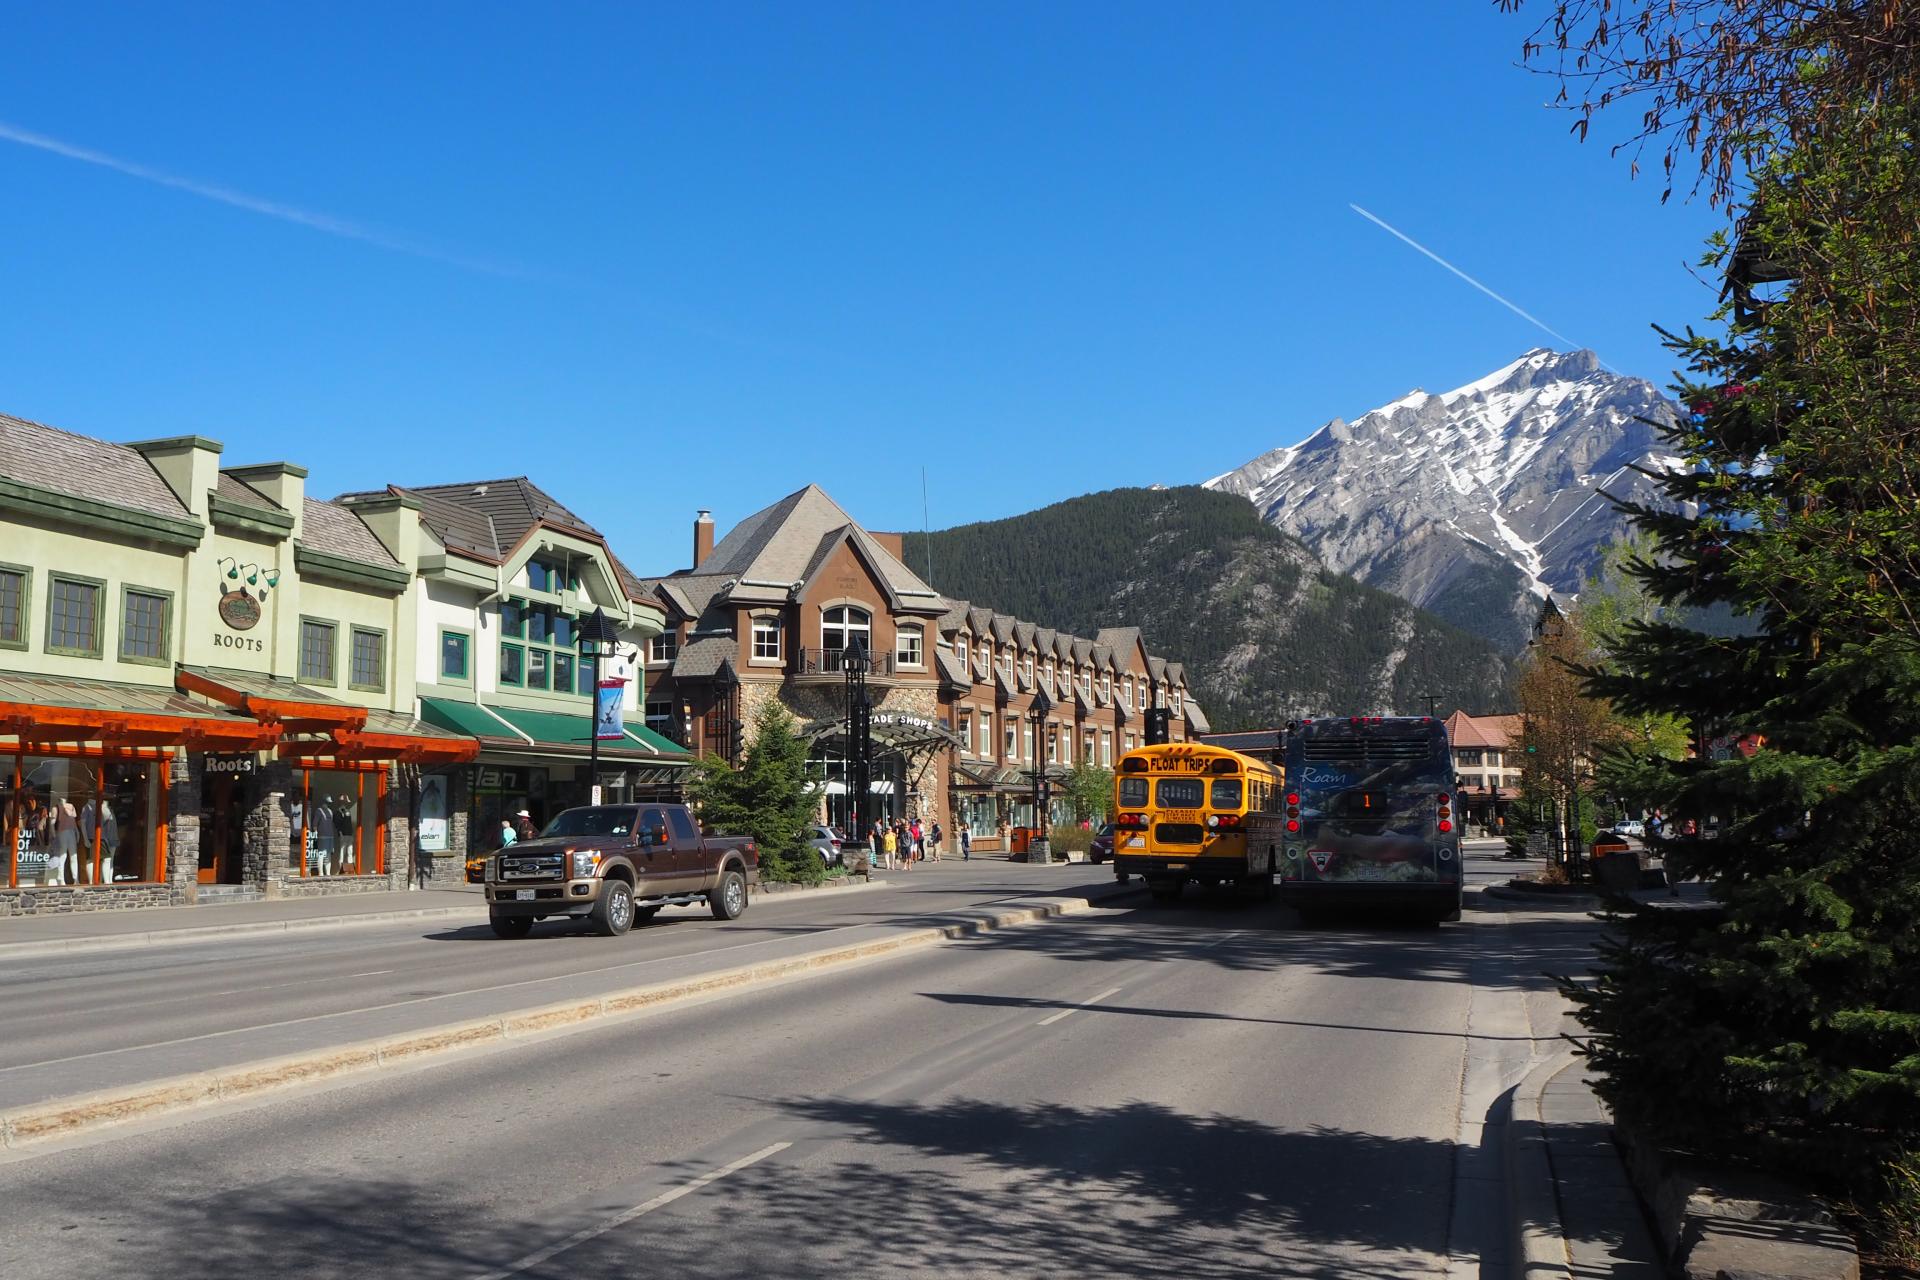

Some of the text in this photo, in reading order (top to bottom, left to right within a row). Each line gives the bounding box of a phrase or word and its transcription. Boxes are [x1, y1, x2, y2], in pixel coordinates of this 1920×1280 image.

[213, 632, 264, 652] ROOTS
[900, 715, 933, 730] SHOPS
[205, 757, 251, 773] Roots
[1150, 757, 1210, 771] FLOAT TRIPS
[1299, 766, 1347, 784] Roam
[1363, 794, 1371, 808] 1
[18, 829, 36, 838] Out
[305, 829, 318, 839] Out
[17, 838, 30, 851] Of
[305, 839, 314, 849] Of
[16, 850, 50, 863] Office
[305, 849, 327, 859] Office
